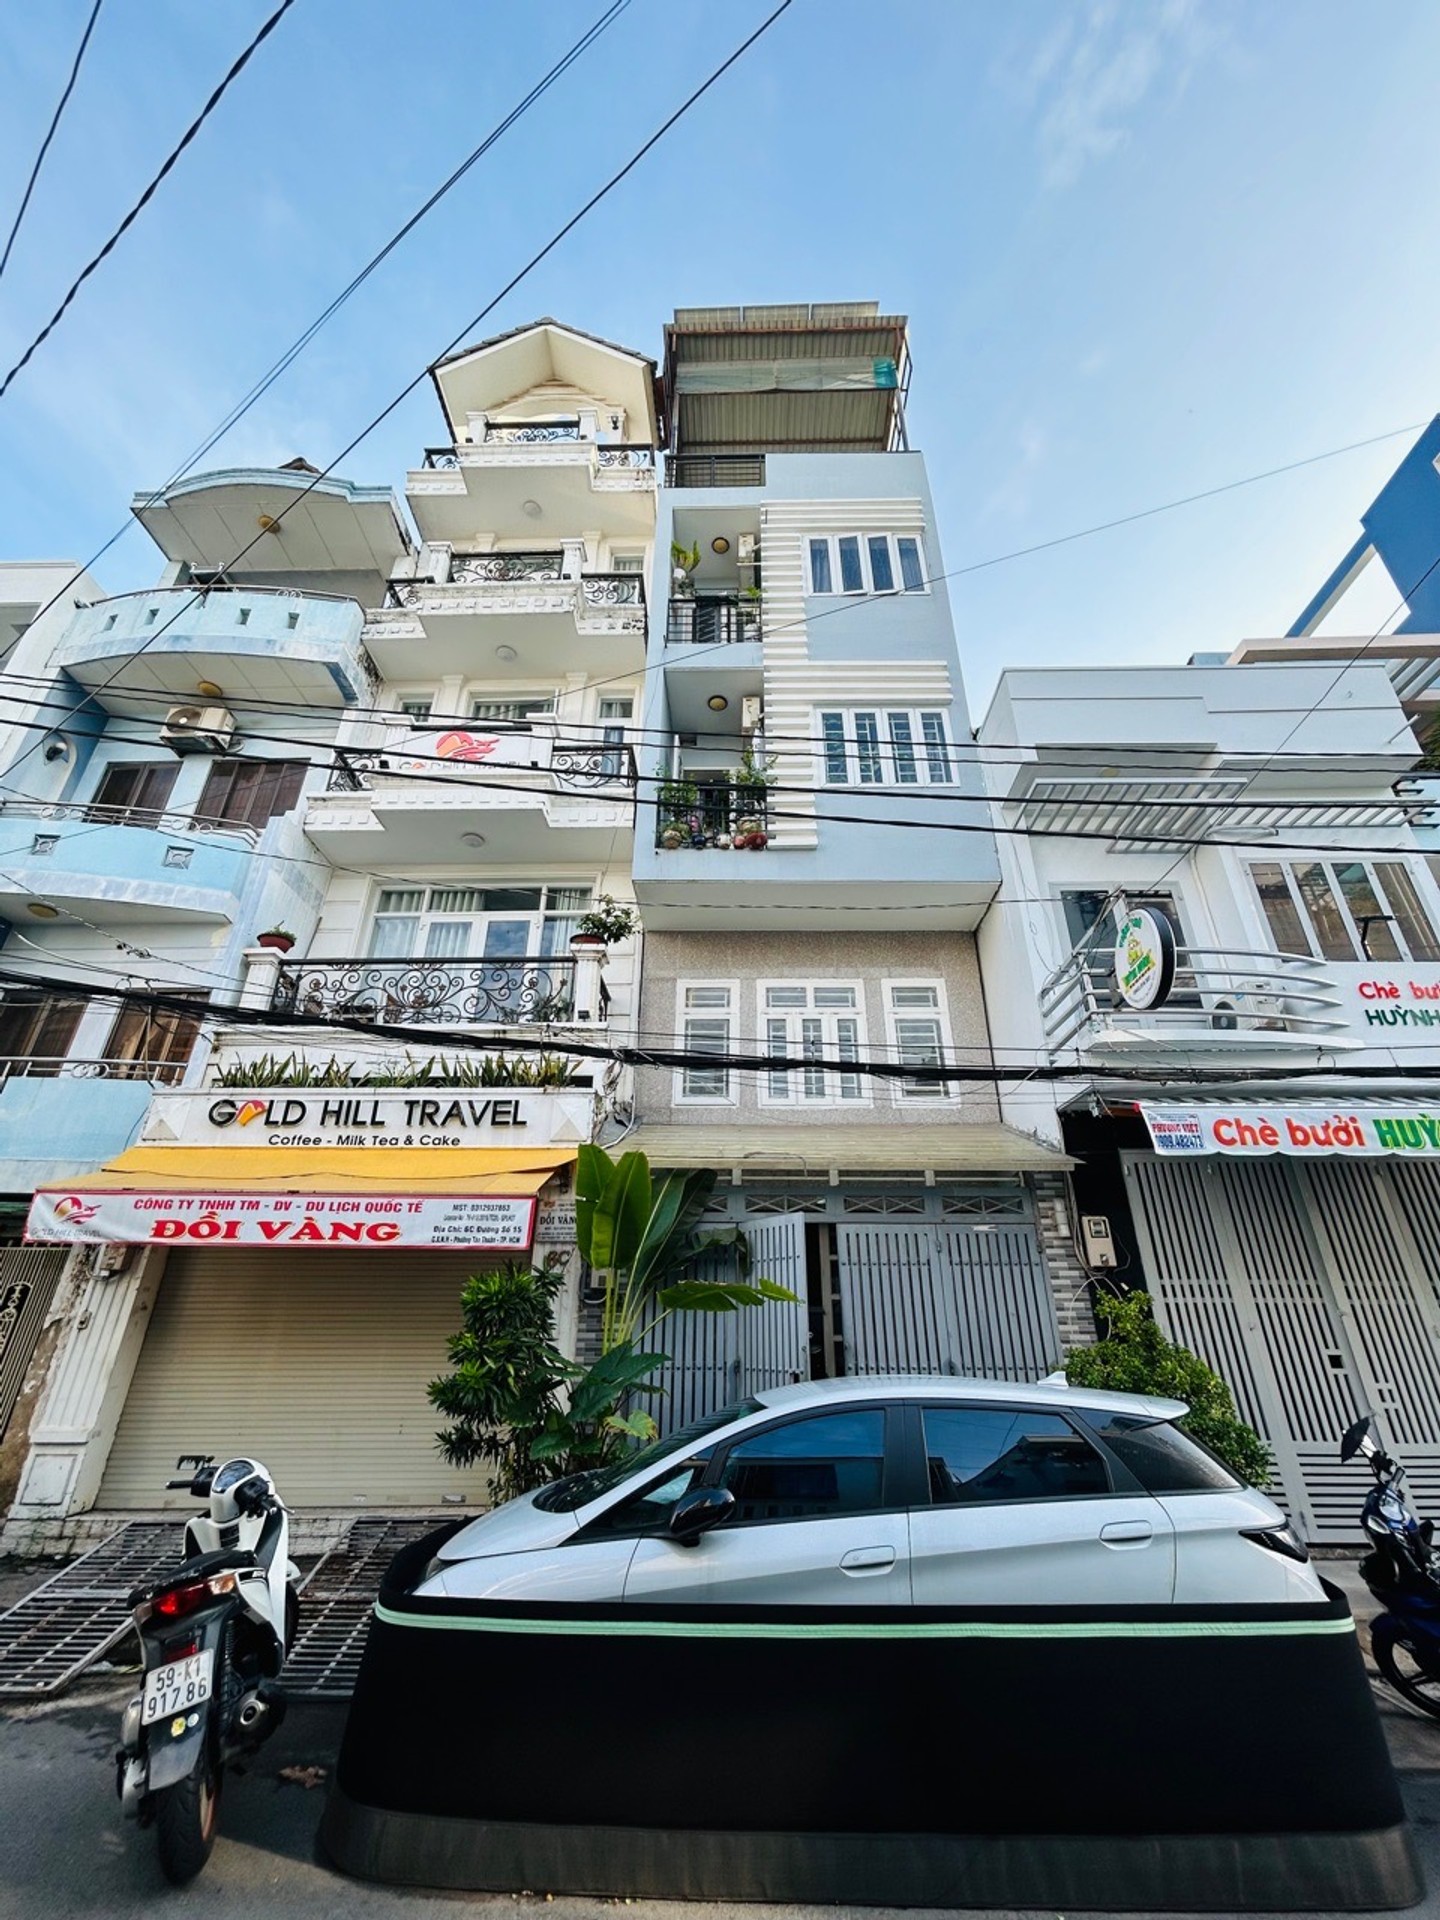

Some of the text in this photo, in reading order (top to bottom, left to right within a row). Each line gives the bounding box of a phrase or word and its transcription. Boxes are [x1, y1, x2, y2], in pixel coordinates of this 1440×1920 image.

[1359, 981, 1440, 999] Chè bư
[320, 1100, 385, 1127] HILL
[404, 1100, 527, 1127] TRAVEL
[268, 1134, 322, 1146] Coffee
[336, 1135, 366, 1146] Milk
[372, 1135, 399, 1146] Tea
[404, 1134, 413, 1146] &
[419, 1134, 460, 1146] Cake
[1213, 1113, 1440, 1149] Chè bưởi HUỲ
[133, 1197, 173, 1210] CÔNG
[178, 1199, 195, 1210] TY
[199, 1200, 235, 1210] TNHH
[239, 1200, 260, 1210] TM
[273, 1201, 292, 1211] DV
[305, 1201, 325, 1212] DU
[328, 1202, 360, 1214] LỊCH
[364, 1198, 402, 1213] QUỐC
[407, 1200, 424, 1213] TẾ
[558, 1213, 577, 1225] VÀN
[150, 1211, 401, 1241] ĐỒI VÀNG
[156, 1657, 201, 1692] 59-K1
[147, 1676, 207, 1718] 917.86
